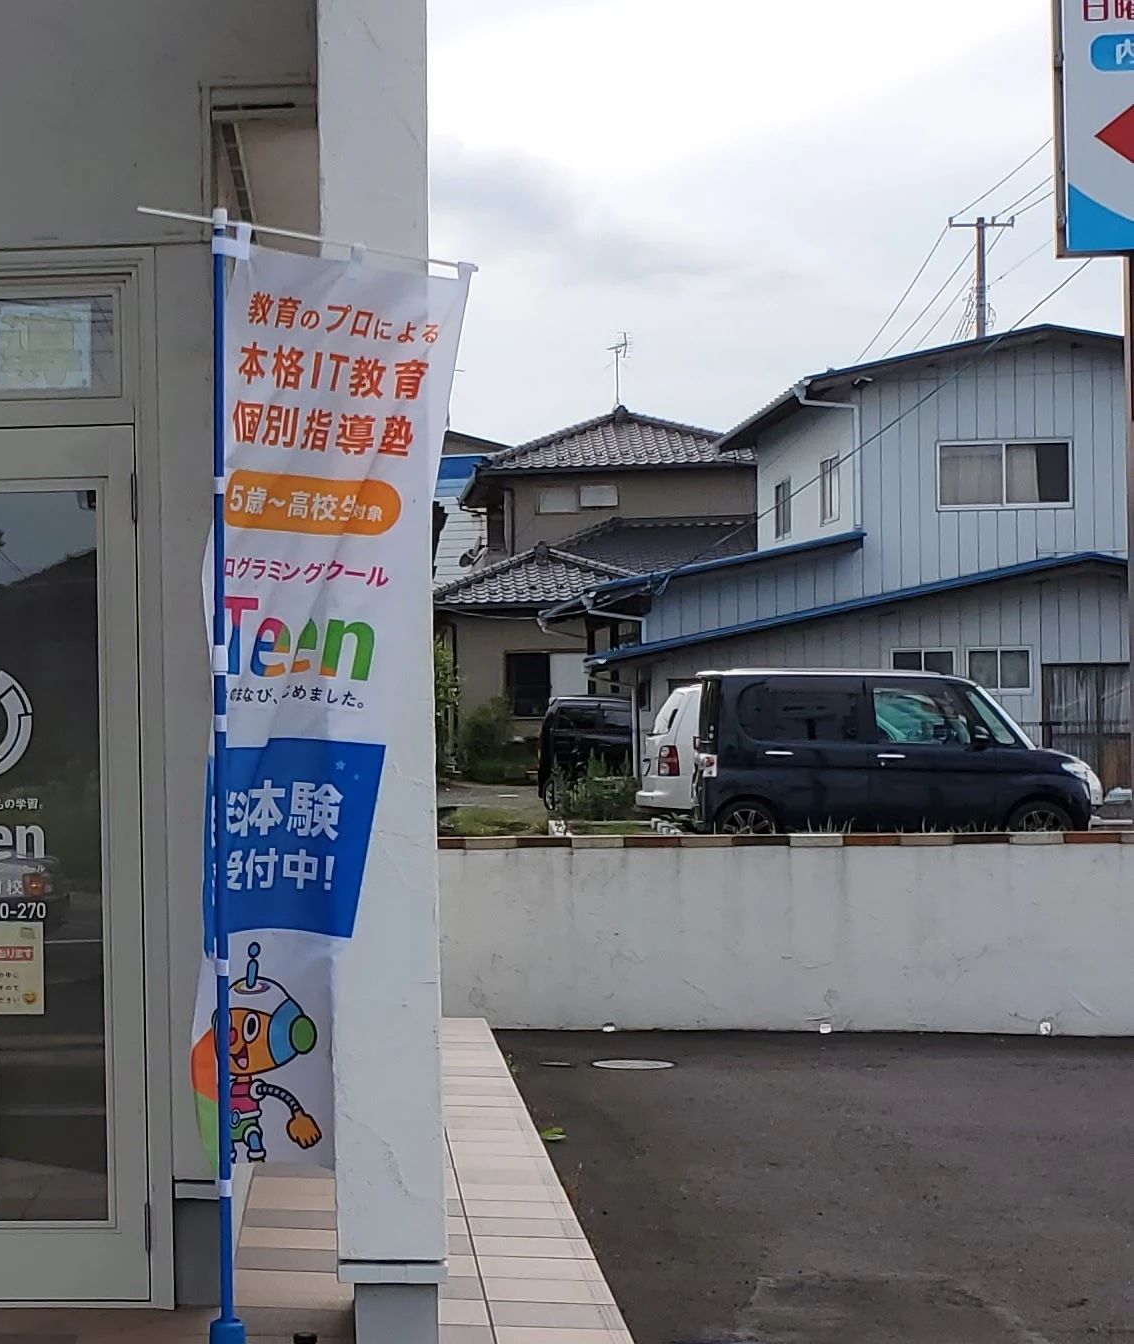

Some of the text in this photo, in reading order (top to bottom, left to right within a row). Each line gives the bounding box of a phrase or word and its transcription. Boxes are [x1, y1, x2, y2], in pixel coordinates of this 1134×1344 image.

[247, 291, 439, 343] 教育のプロによる
[238, 341, 429, 400] 本格IT教育
[232, 399, 414, 457] 個別指導塾
[224, 557, 389, 587] ログラミングクール
[224, 596, 375, 681] Teen
